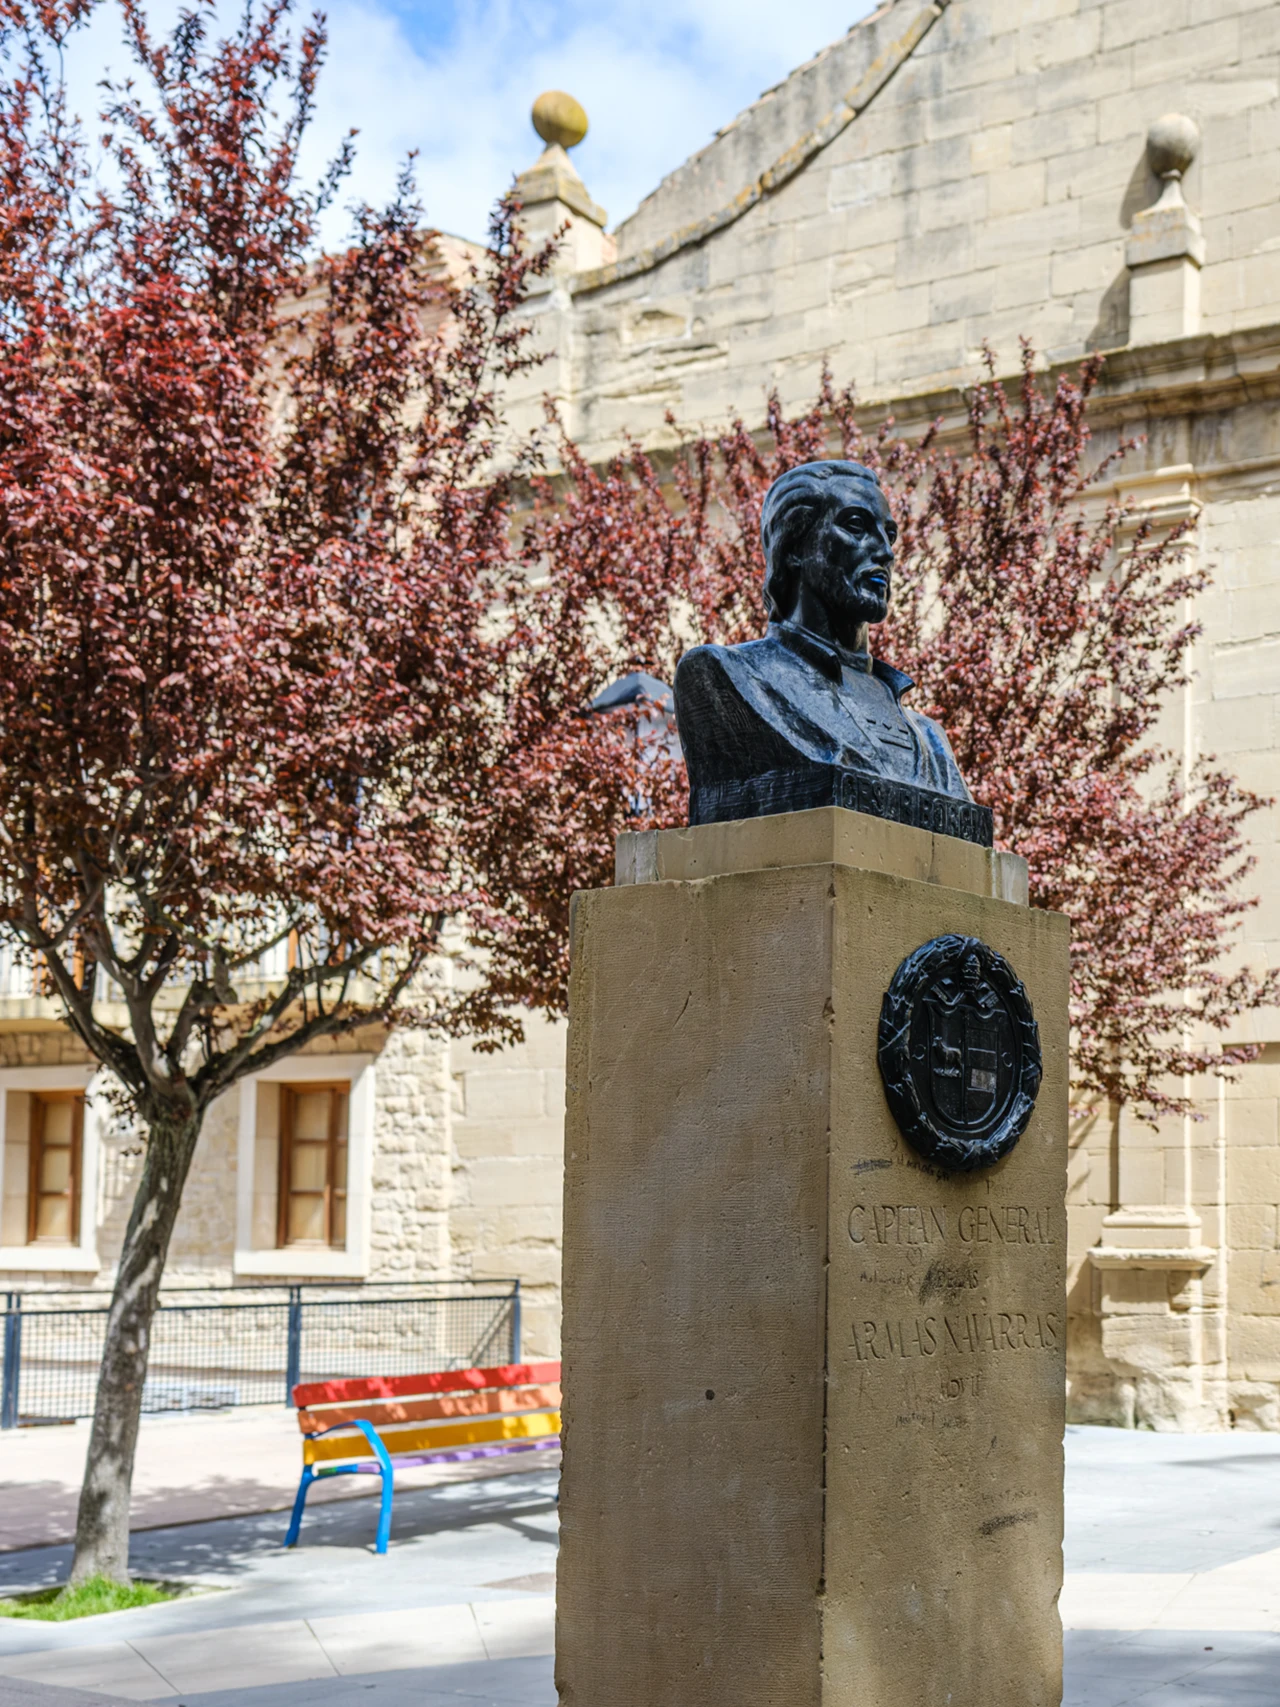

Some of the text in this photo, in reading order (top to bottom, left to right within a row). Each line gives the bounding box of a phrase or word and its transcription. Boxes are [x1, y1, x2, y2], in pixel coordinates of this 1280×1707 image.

[847, 1204, 1055, 1245] CAPITAN GENERAL
[844, 1311, 1061, 1362] ARMAS NAVARRAS
